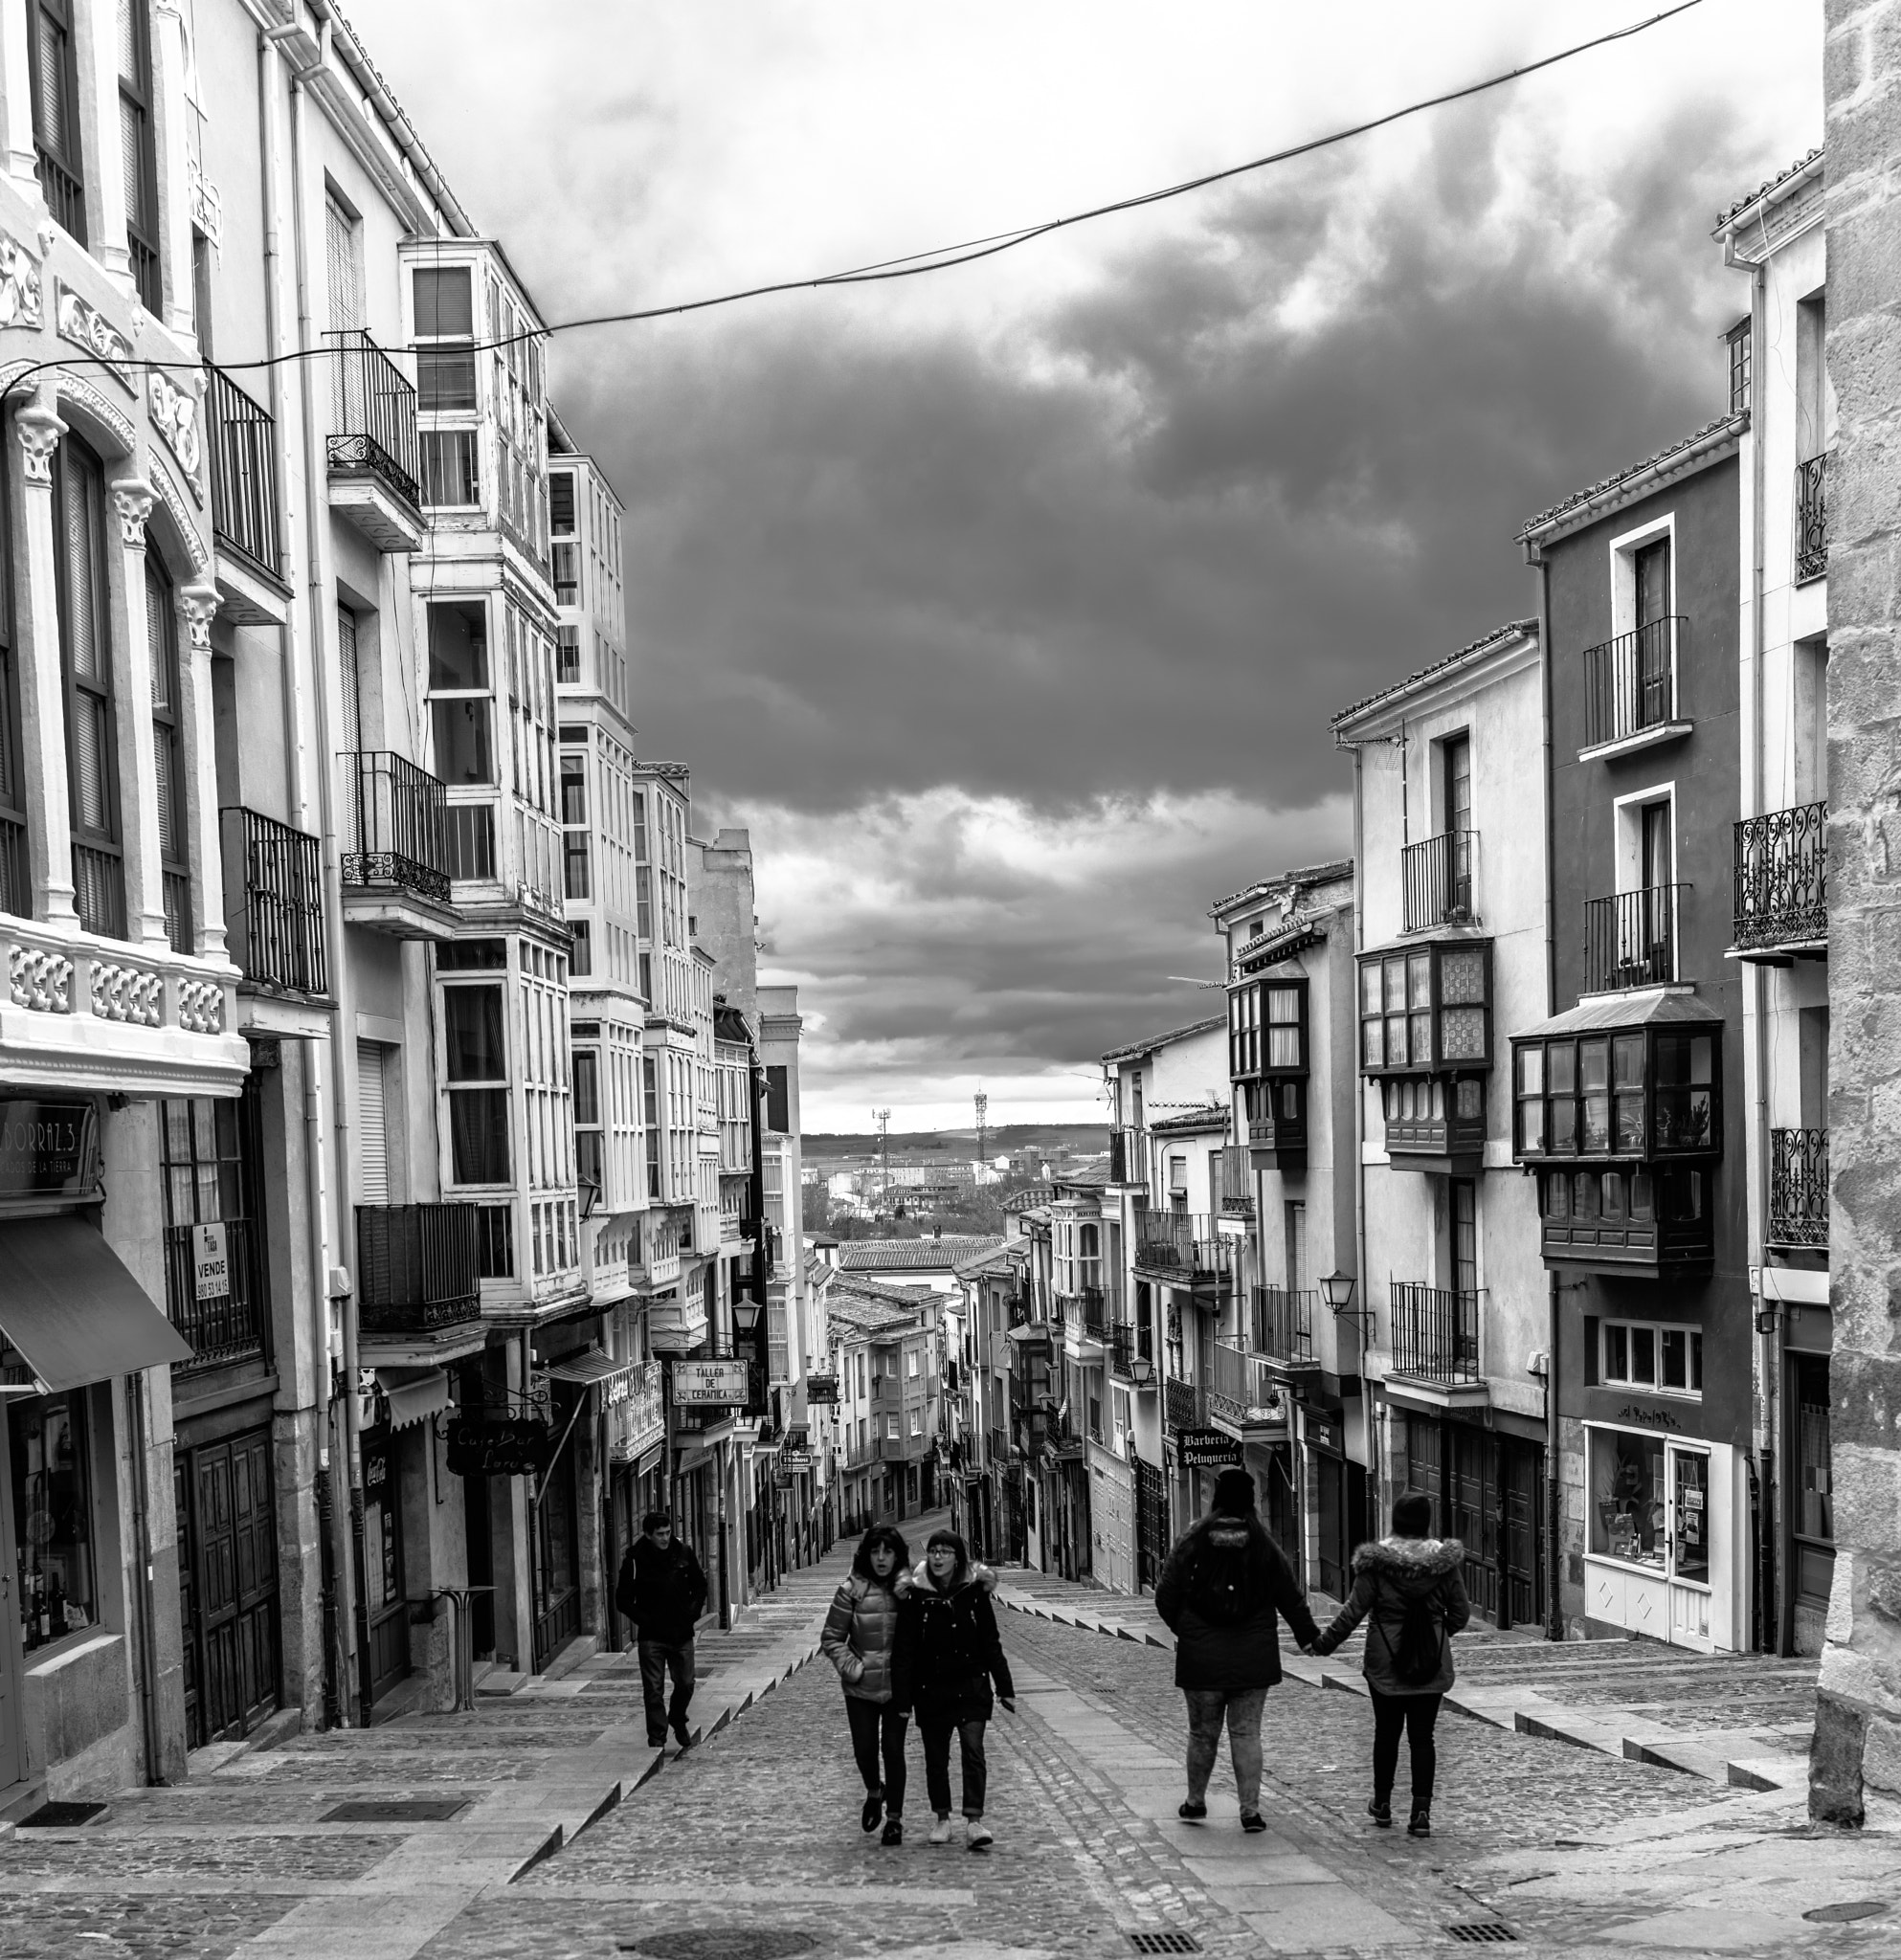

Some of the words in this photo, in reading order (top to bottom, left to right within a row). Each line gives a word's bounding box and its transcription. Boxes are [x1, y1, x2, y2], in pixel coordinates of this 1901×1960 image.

[0, 1122, 76, 1152] BORRAZ.3
[28, 1161, 36, 1173] DE
[39, 1161, 47, 1173] LA
[50, 1160, 72, 1173] TIERRA
[197, 1260, 225, 1279] VENDE
[696, 1368, 725, 1378] TALLER
[705, 1378, 716, 1389] DE
[692, 1390, 727, 1400] CERAMICA
